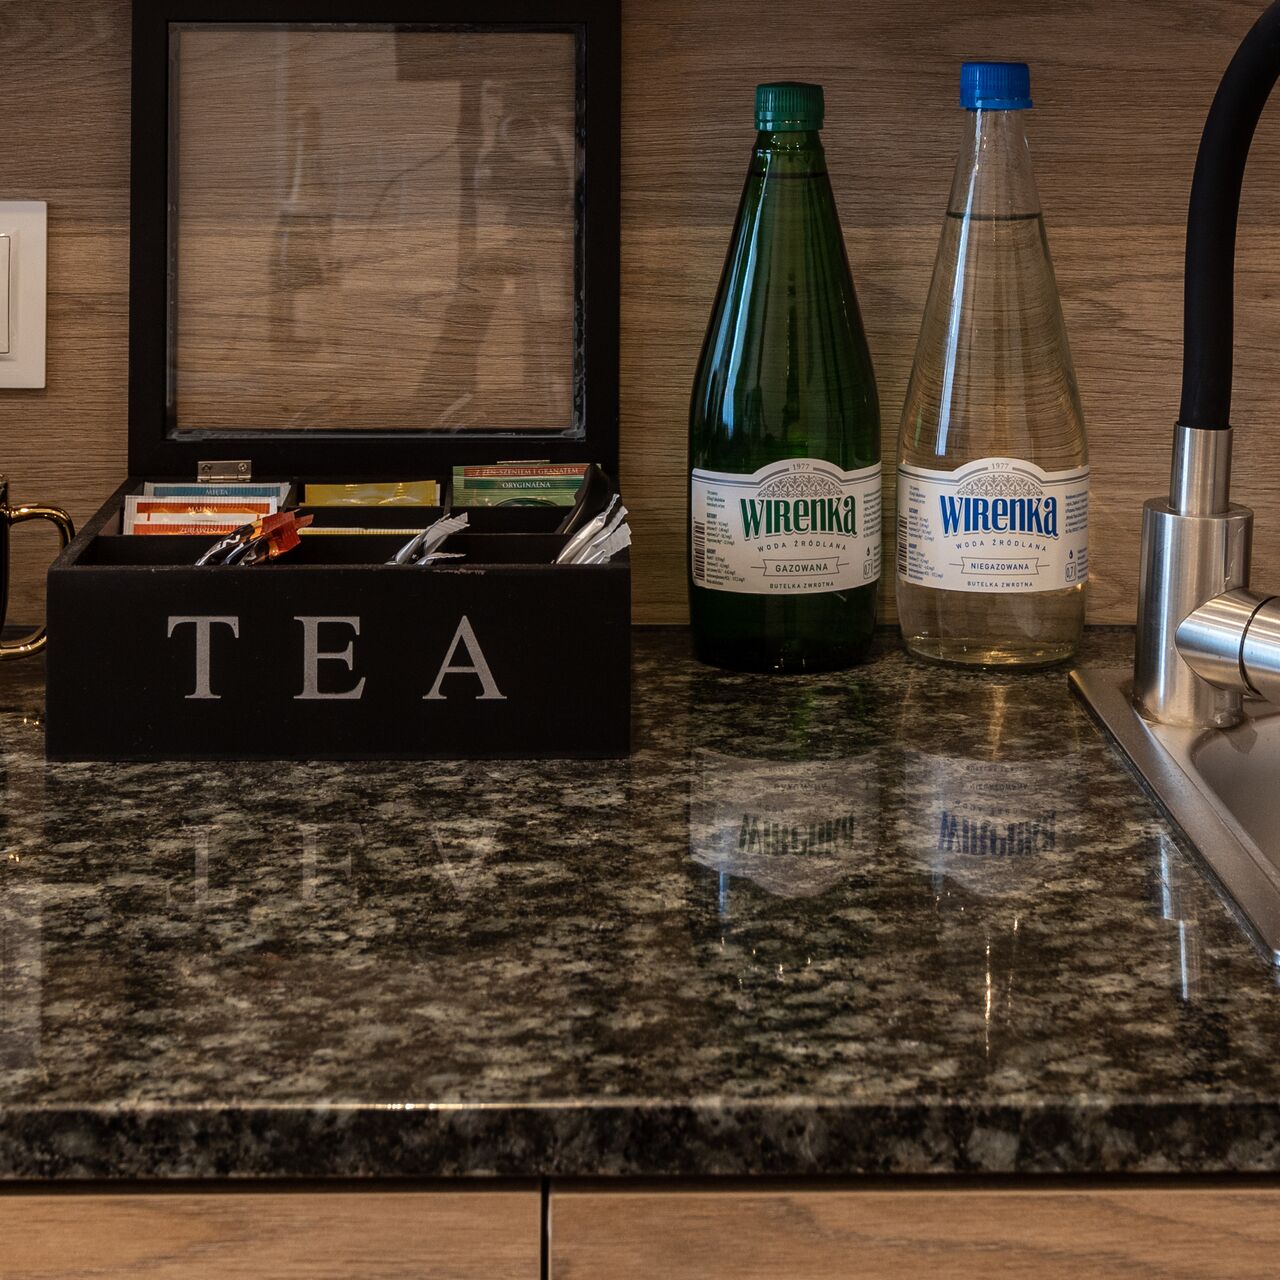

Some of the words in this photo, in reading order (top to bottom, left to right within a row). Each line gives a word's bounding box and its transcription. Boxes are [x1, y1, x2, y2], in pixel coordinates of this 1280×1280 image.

[792, 463, 810, 471] 1977
[991, 462, 1009, 470] 1977
[757, 541, 787, 552] WODA
[955, 540, 985, 550] WODA
[775, 563, 828, 573] GAZOWANA
[970, 562, 1029, 571] NIEGAZOWANA
[803, 581, 834, 589] ZWROTNA
[167, 615, 507, 699] TEA
